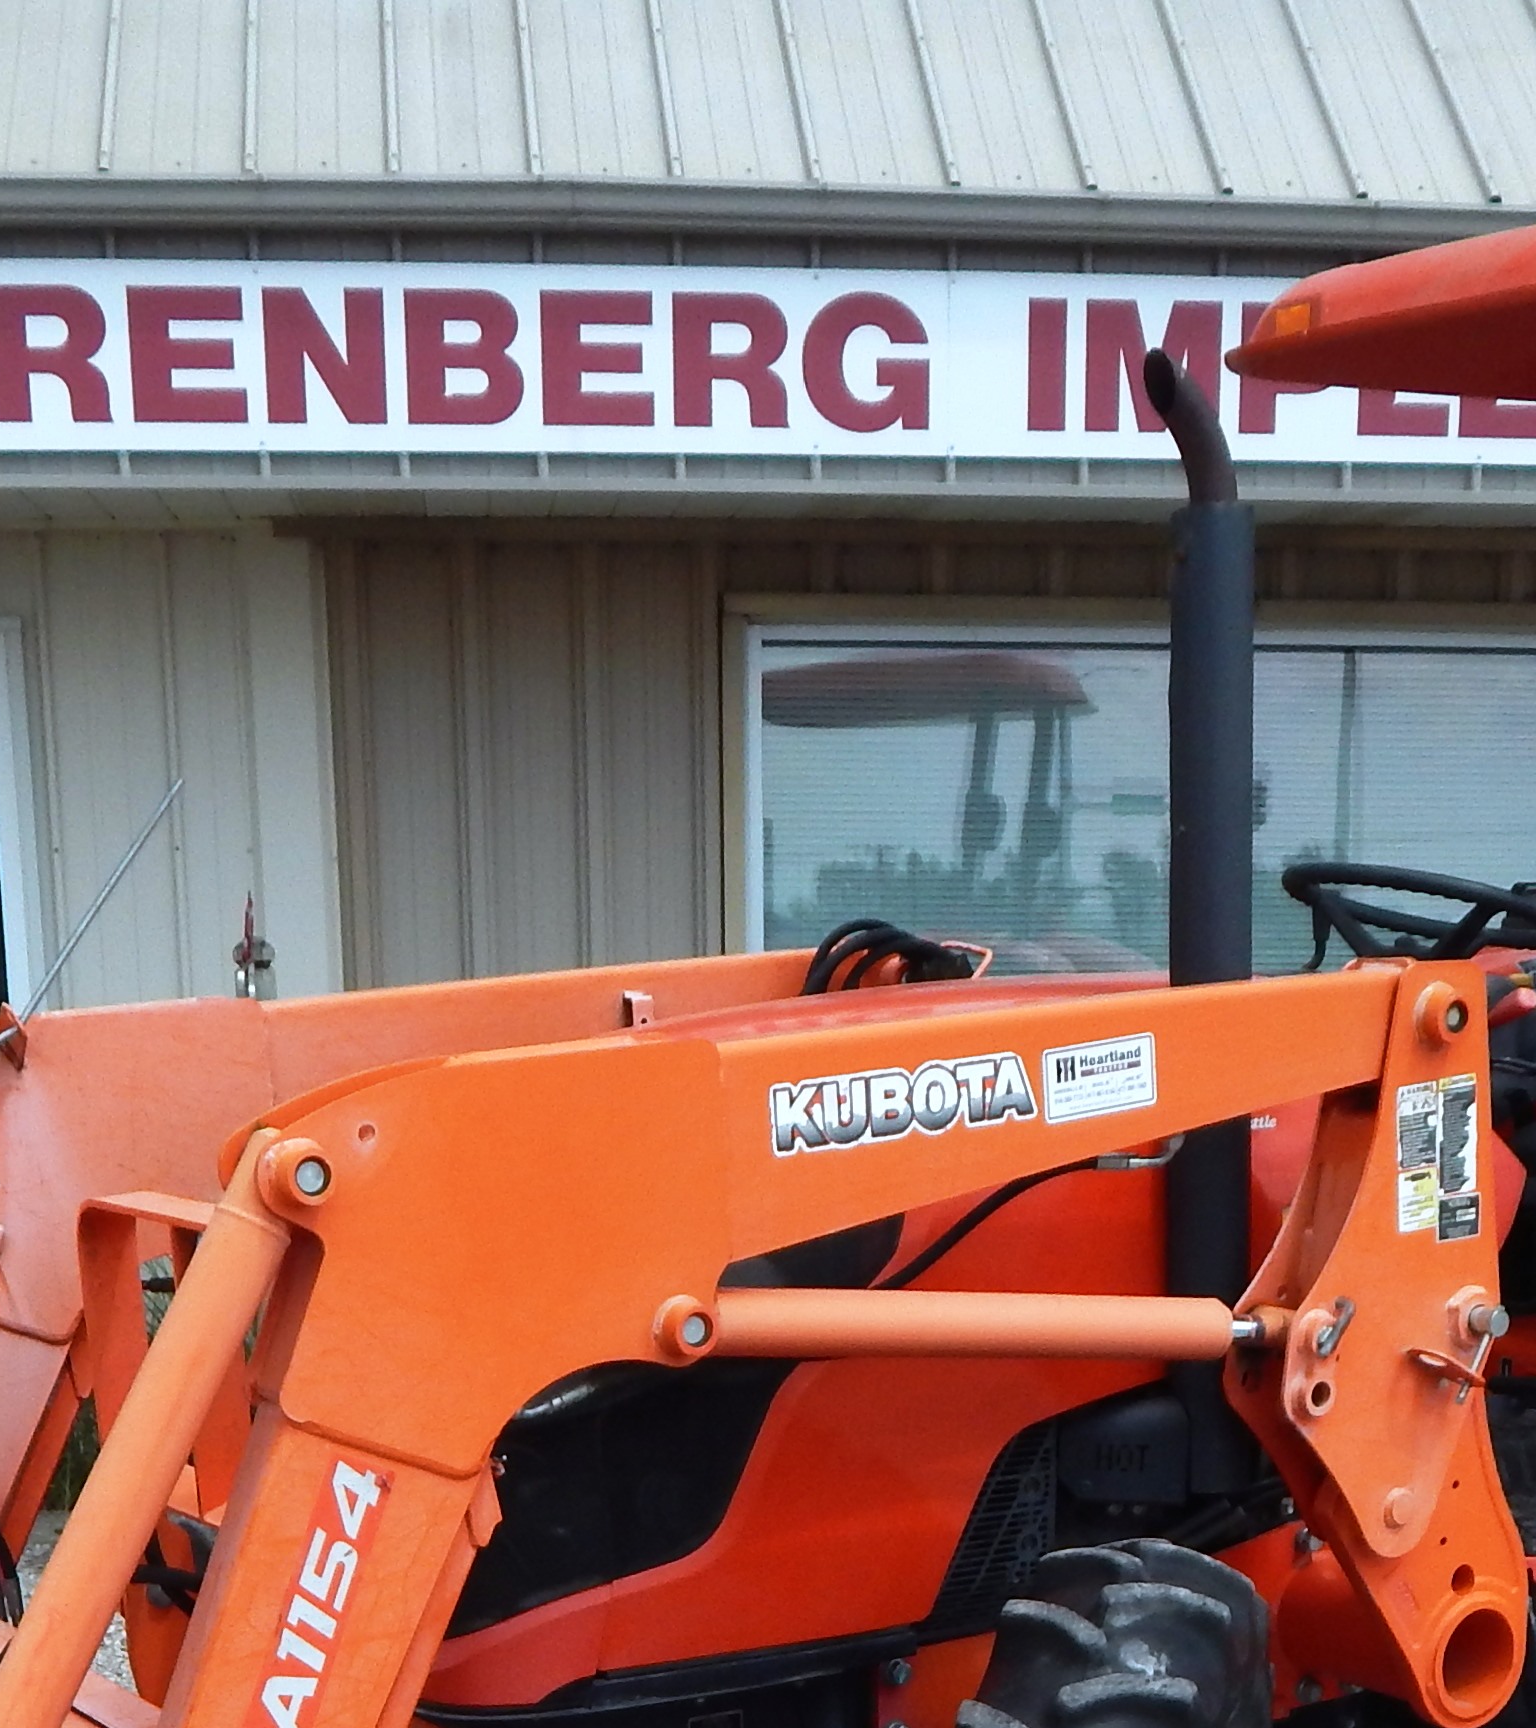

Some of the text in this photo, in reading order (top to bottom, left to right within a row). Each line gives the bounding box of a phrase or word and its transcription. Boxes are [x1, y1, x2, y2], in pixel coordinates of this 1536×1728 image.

[1079, 1046, 1141, 1068] Heartland
[773, 1056, 1034, 1152] KUBOTA
[1095, 1443, 1151, 1473] HOT
